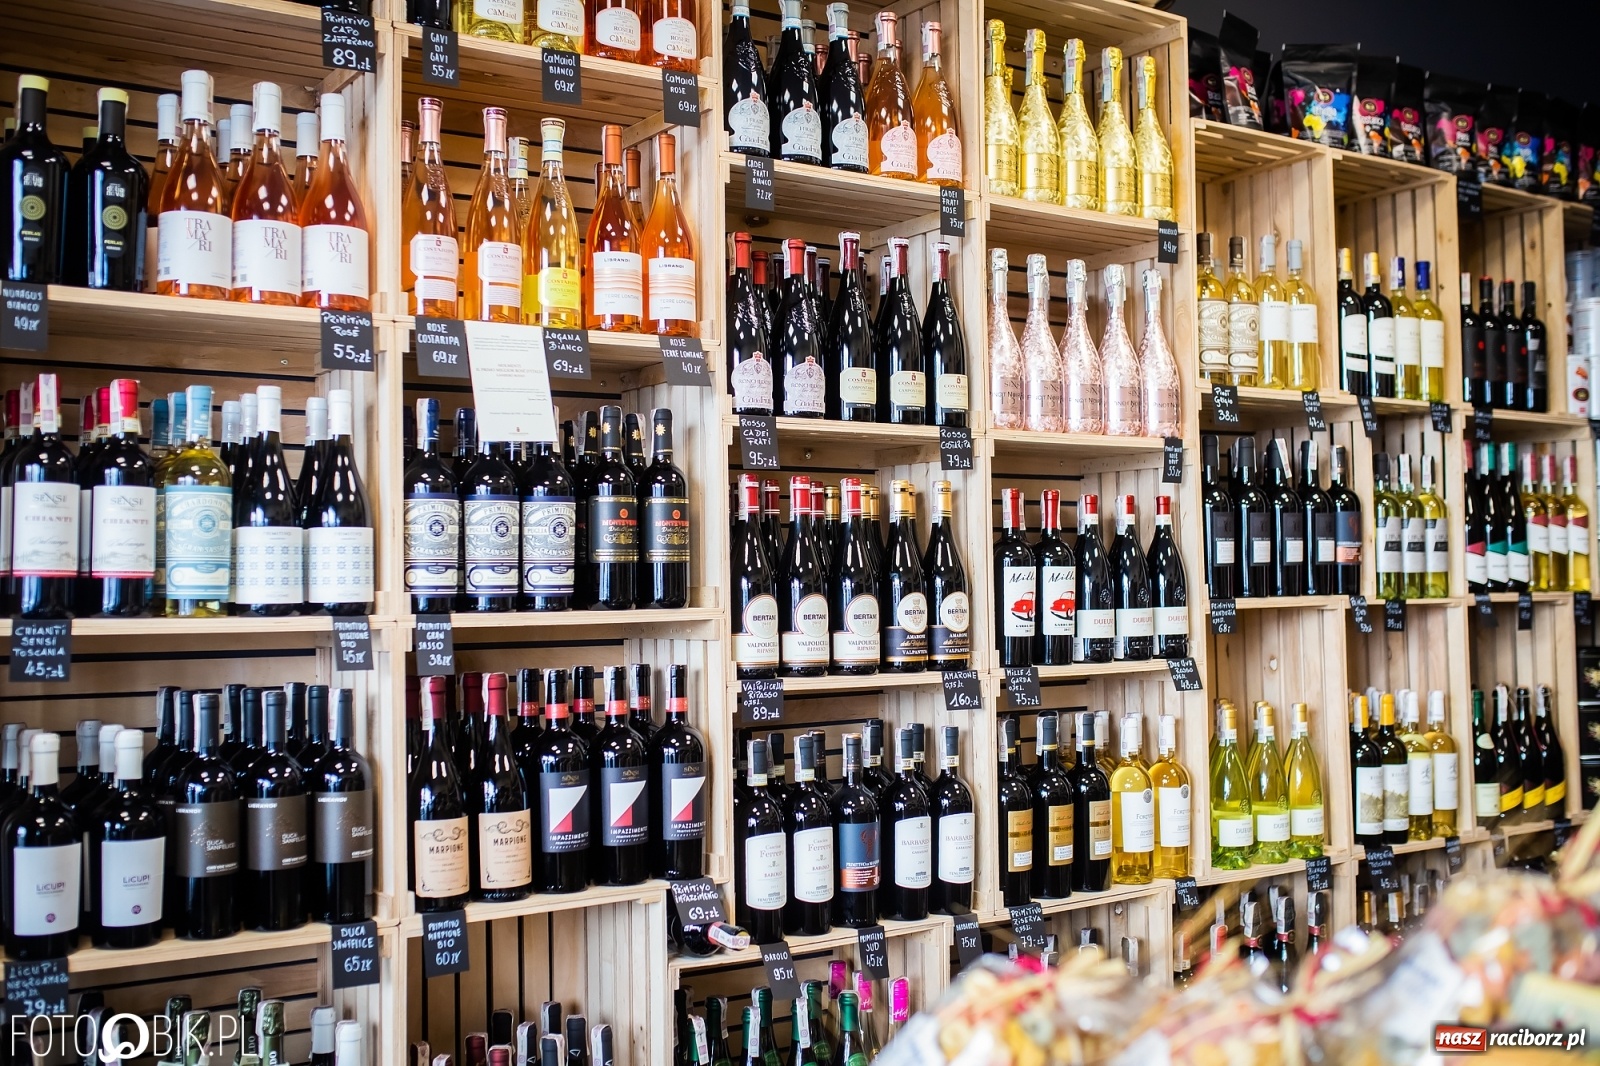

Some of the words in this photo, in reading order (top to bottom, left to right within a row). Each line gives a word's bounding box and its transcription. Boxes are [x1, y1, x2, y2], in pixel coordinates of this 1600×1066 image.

[324, 12, 371, 27] PRIMITIVO
[334, 26, 362, 38] CAPO
[430, 32, 449, 46] GAVI
[434, 45, 444, 54] DI
[430, 52, 449, 66] GAVI
[549, 65, 574, 78] BIANCO
[669, 86, 687, 96] ROSE
[198, 240, 213, 253] RI
[275, 248, 288, 261] RI
[339, 252, 352, 264] RI
[321, 311, 371, 327] PRIMITIVO
[425, 323, 449, 334] ROSE
[416, 332, 461, 347] COSTARIPA
[669, 338, 686, 348] ROSE
[548, 341, 584, 353] BIANCO
[741, 418, 767, 429] ROSSO
[940, 428, 968, 440] ROSSO
[32, 492, 68, 505] SENSI
[111, 495, 145, 508] SENSI
[25, 515, 74, 524] CHIANTI
[102, 517, 150, 526] CHIANTI
[14, 623, 68, 638] CHIANTI
[20, 635, 58, 647] SENSI
[943, 671, 978, 685] AMARONE
[747, 689, 779, 701] RIPASSO
[494, 834, 528, 847] MARPIONE
[428, 842, 465, 855] MARPIONE
[1010, 907, 1042, 921] PRIMITIVO
[339, 925, 366, 939] DUCA
[764, 951, 789, 963] BAROLO
